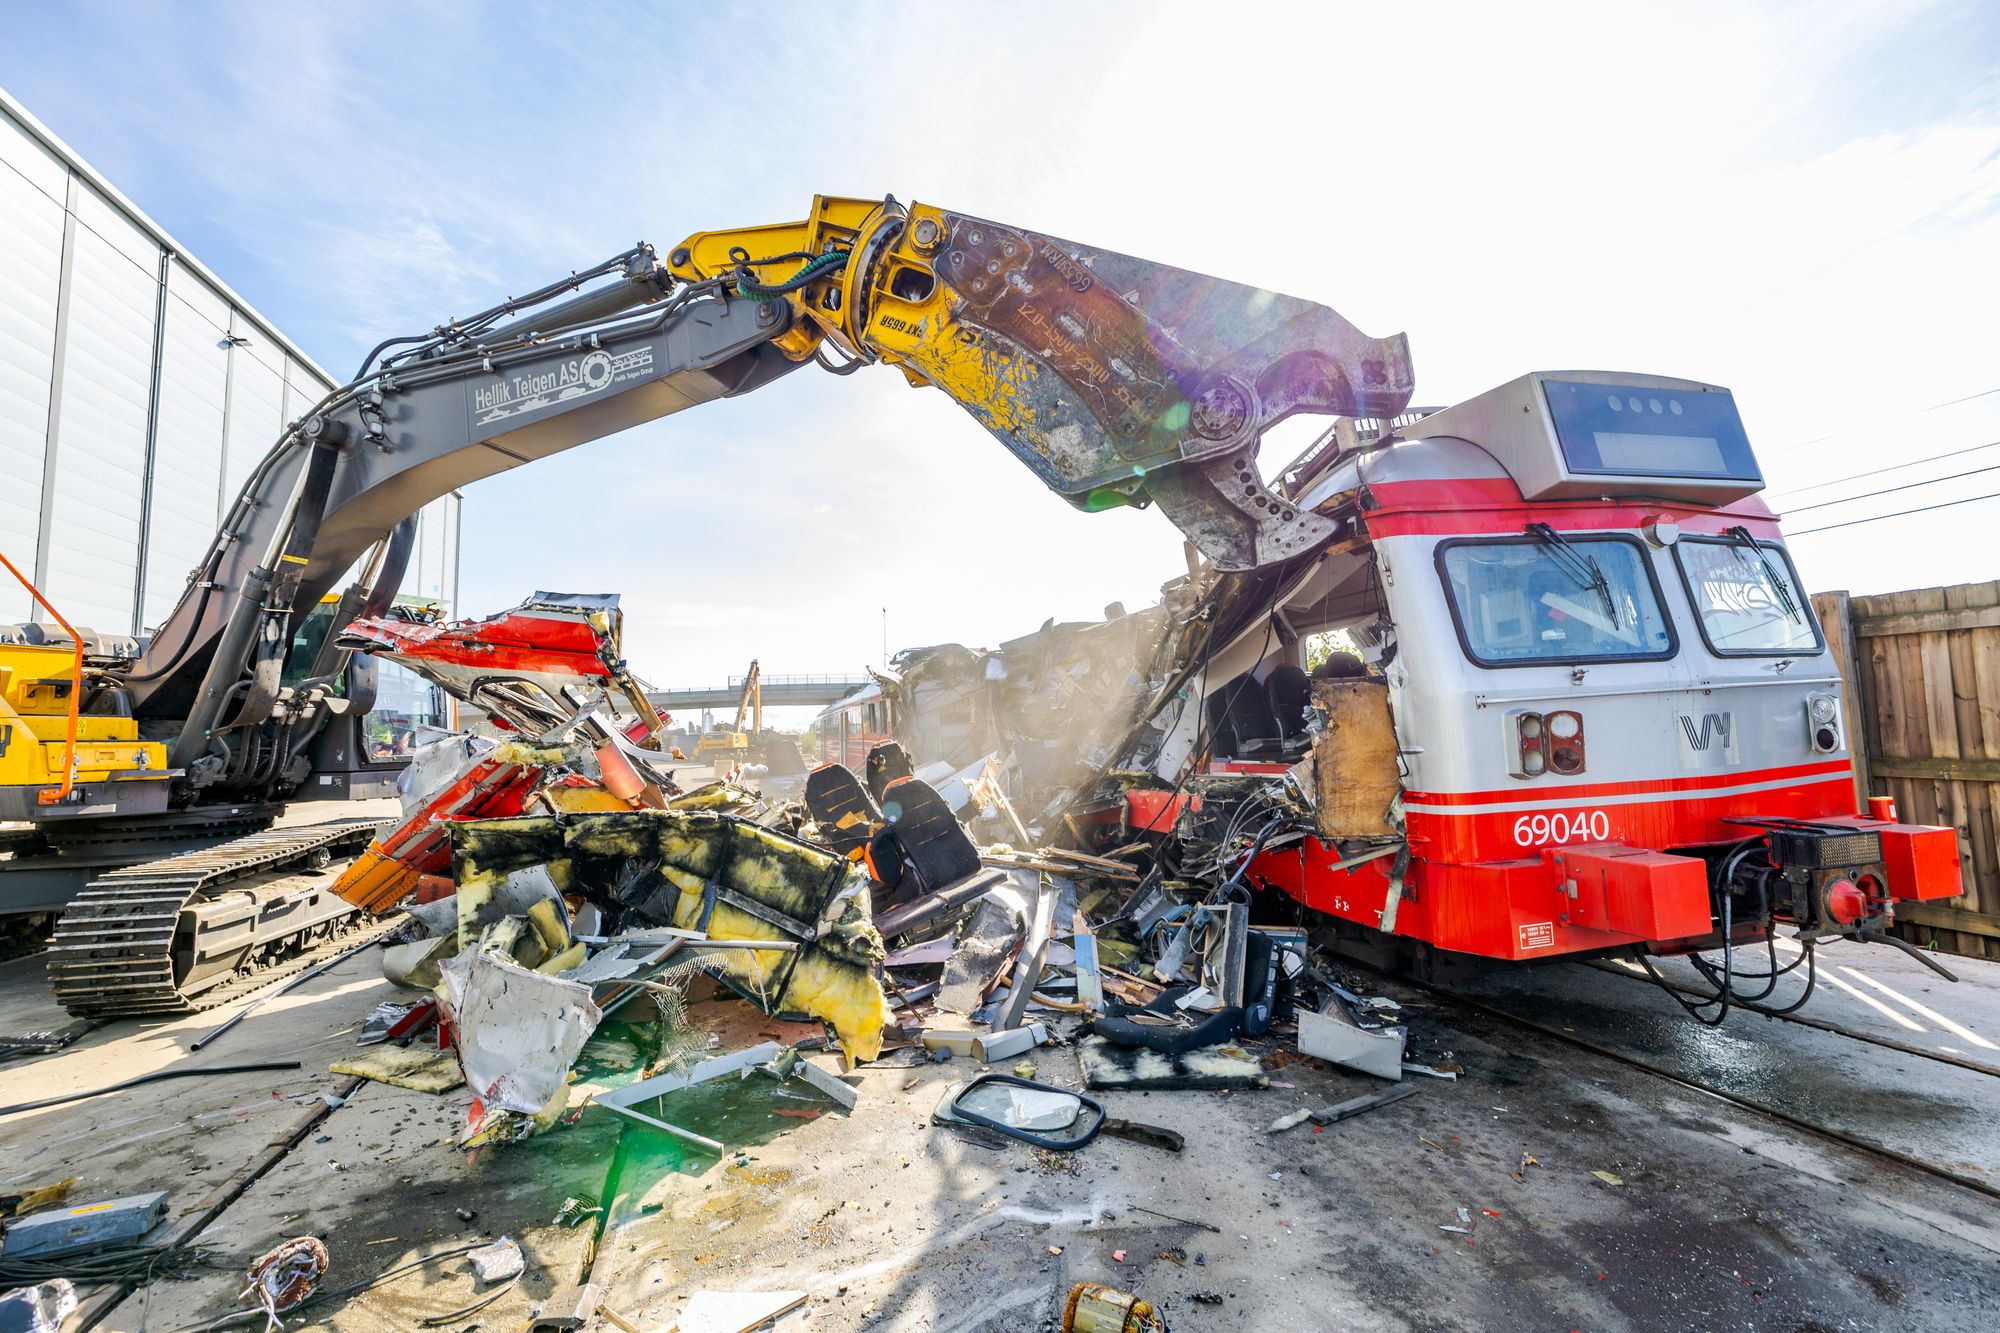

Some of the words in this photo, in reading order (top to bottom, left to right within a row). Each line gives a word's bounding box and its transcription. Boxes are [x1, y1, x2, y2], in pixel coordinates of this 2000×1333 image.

[880, 315, 906, 331] 665R
[475, 381, 511, 410] Hellik
[513, 371, 557, 397] Teigen
[560, 360, 579, 386] AS
[614, 373, 631, 383] Hellik
[626, 370, 640, 380] Teigen
[640, 367, 654, 375] Group
[1513, 810, 1610, 847] 69040
